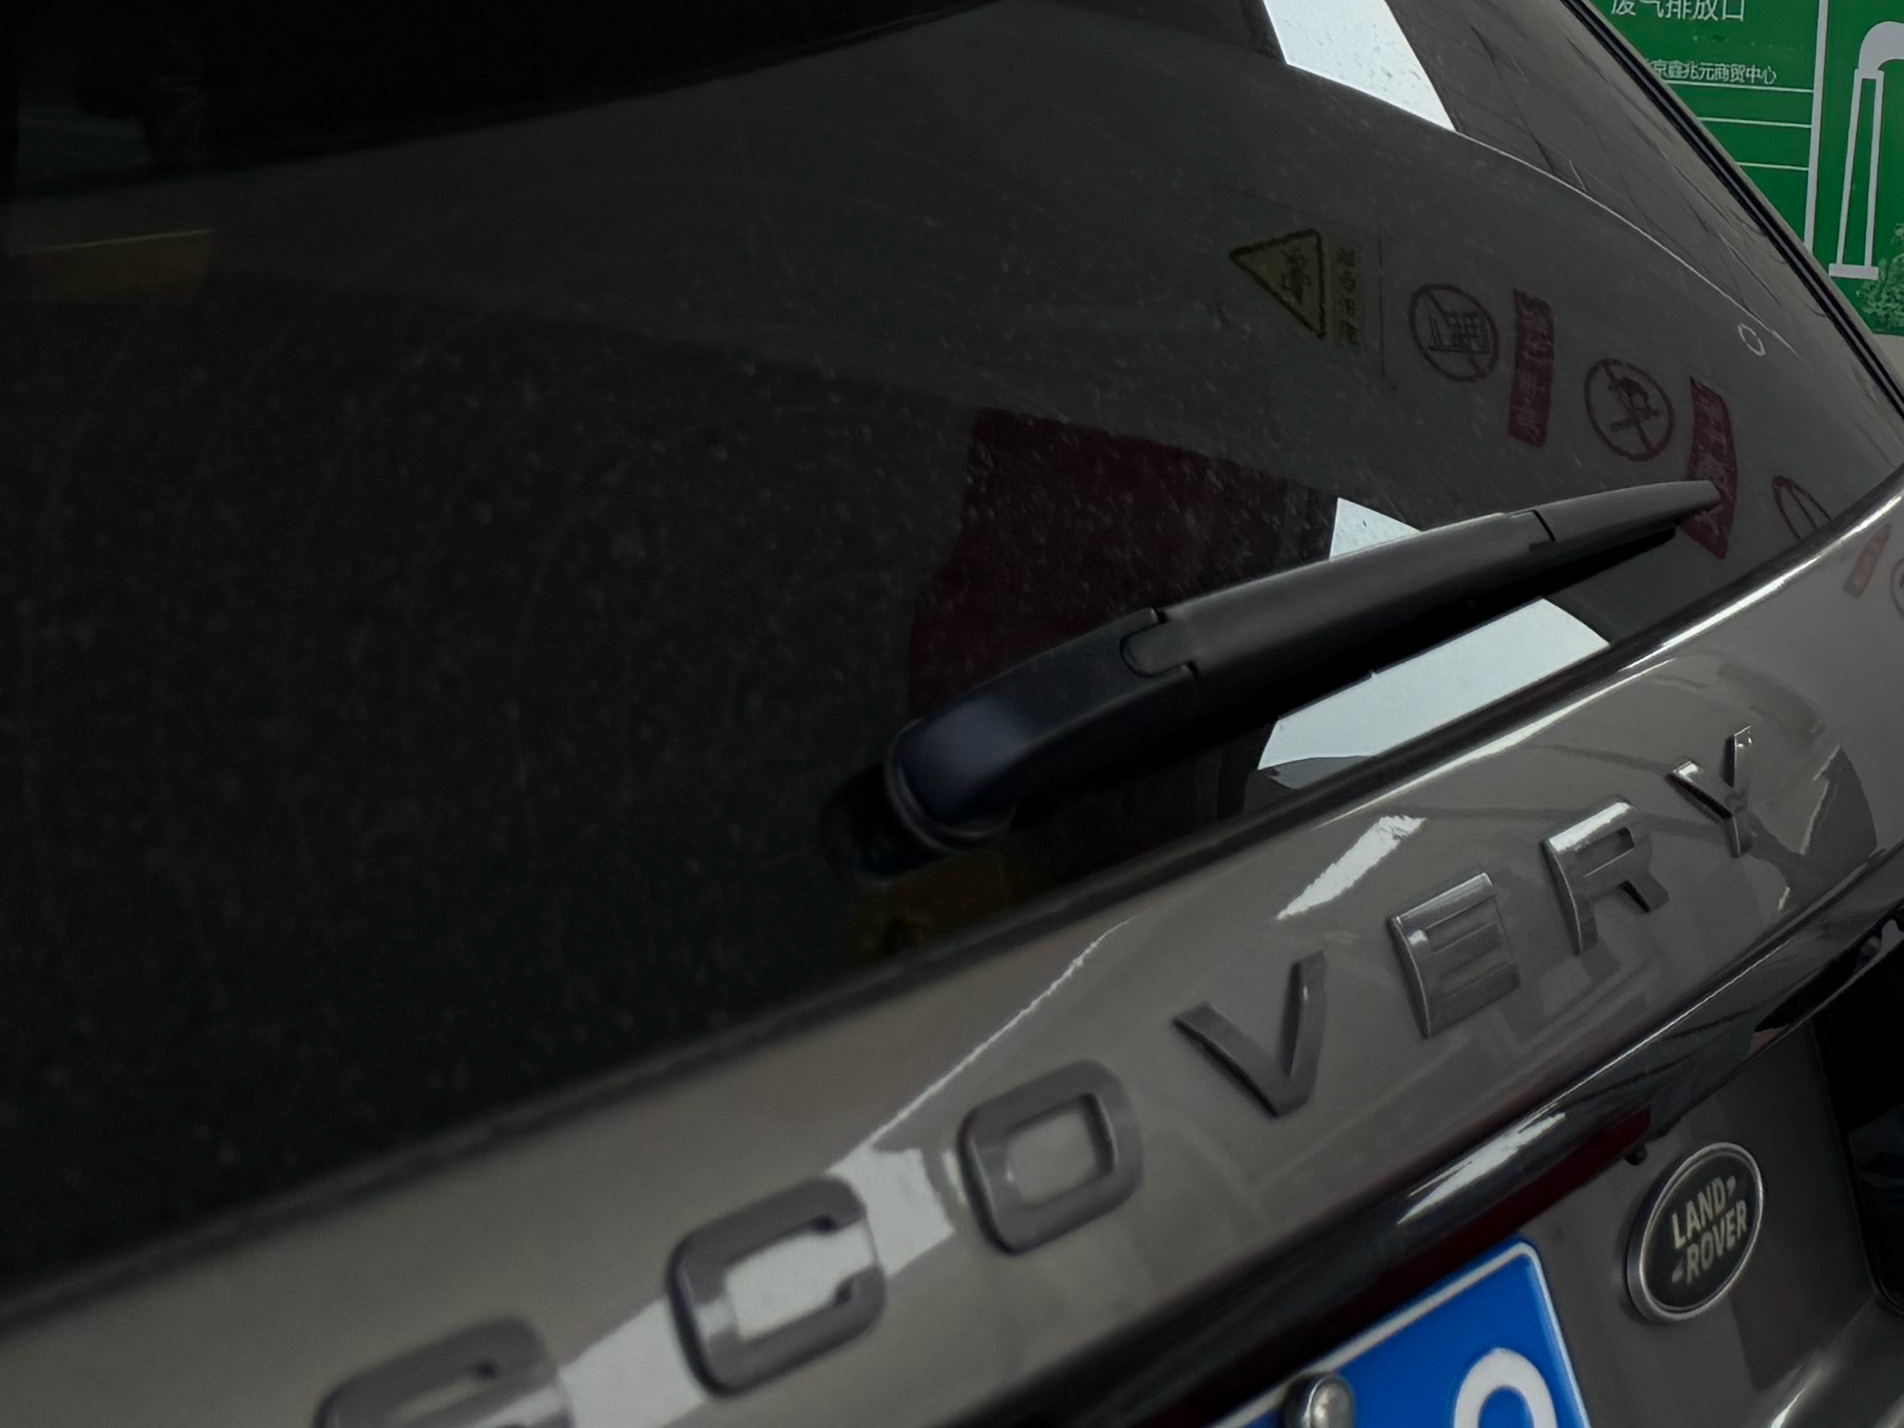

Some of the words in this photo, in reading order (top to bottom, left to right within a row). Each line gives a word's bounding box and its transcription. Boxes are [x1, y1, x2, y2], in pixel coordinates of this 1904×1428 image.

[1646, 58, 1777, 85] 京鑫兆元商贸中心
[1672, 1176, 1726, 1250] LAND
[1686, 1200, 1747, 1284] ROVER
